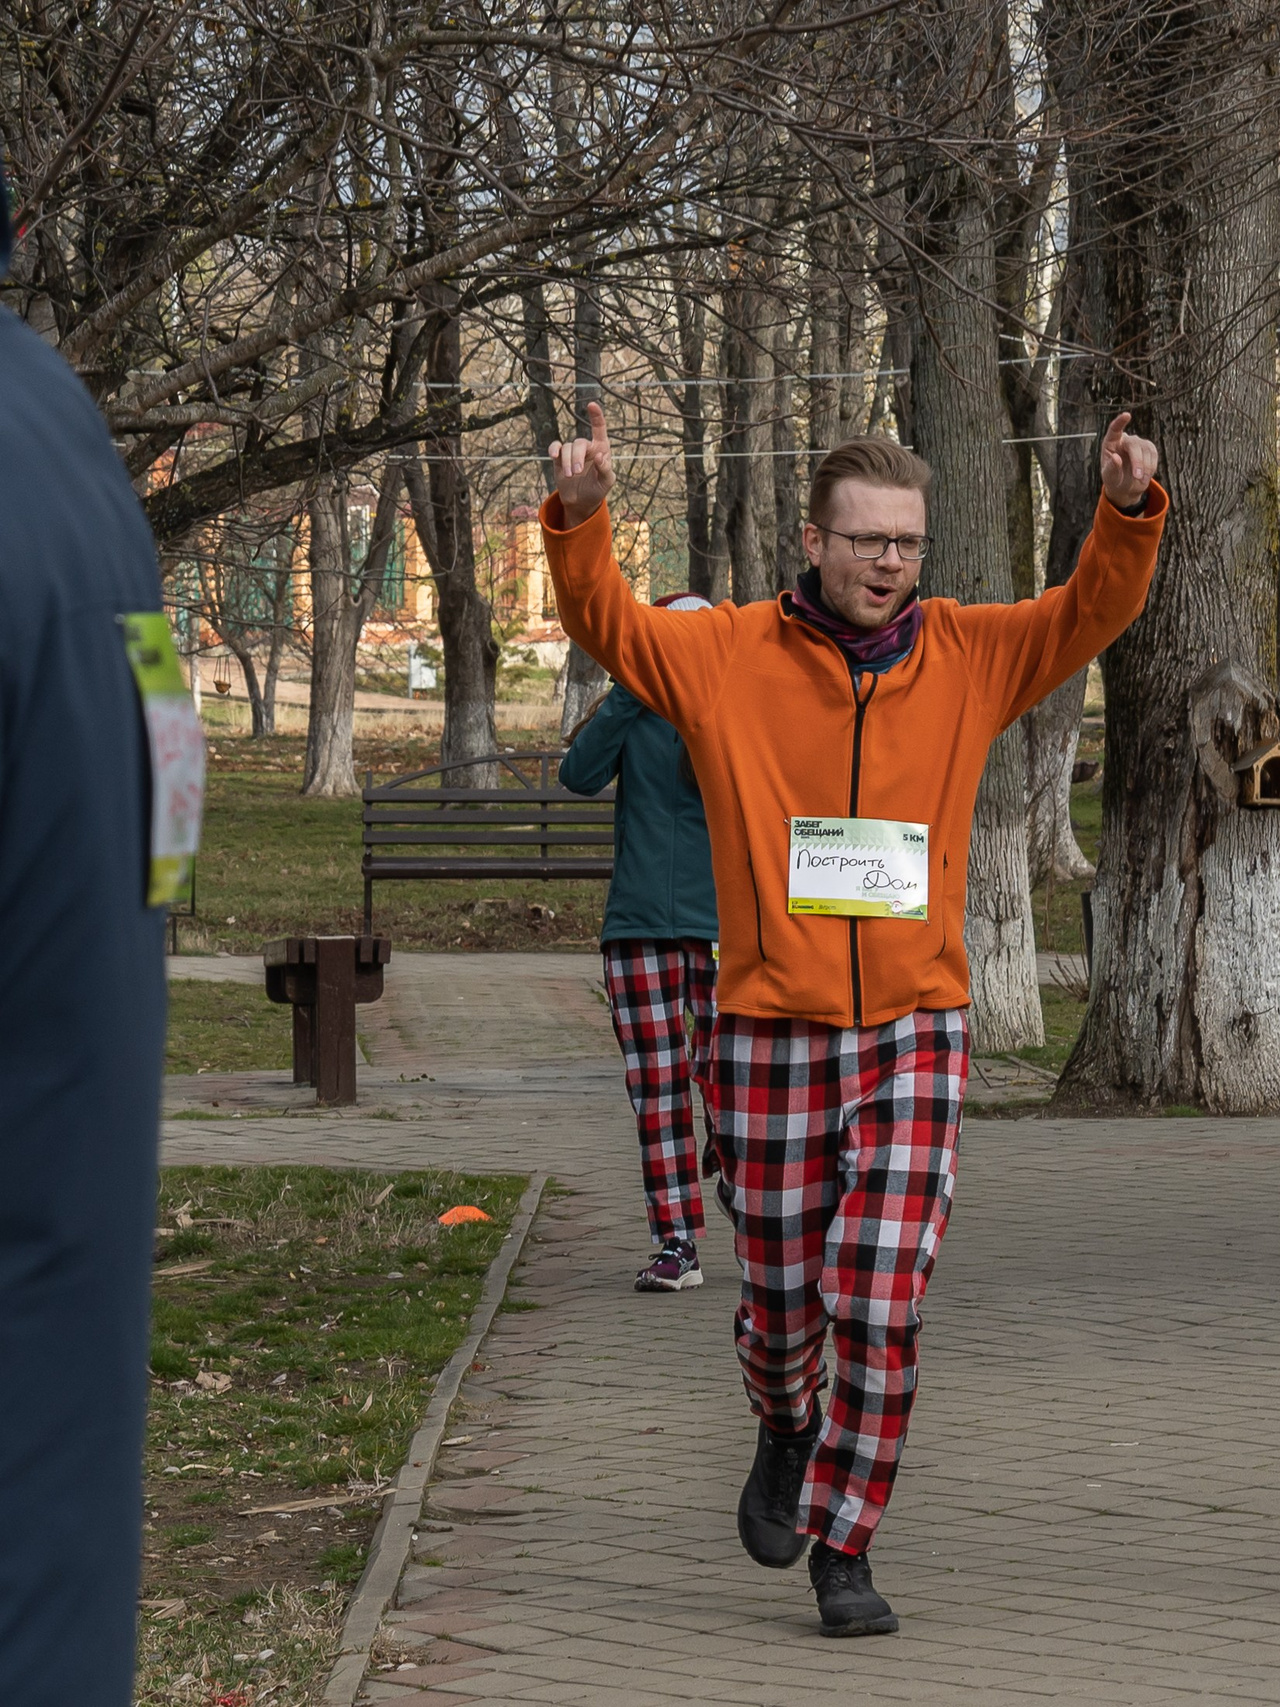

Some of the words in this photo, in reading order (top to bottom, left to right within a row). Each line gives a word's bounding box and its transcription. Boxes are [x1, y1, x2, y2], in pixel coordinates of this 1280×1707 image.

[794, 820, 823, 829] ЗАБЕГ
[794, 827, 844, 838] ОБЕЩАНИЙ
[910, 835, 924, 843] КМ
[796, 849, 885, 872] Построить
